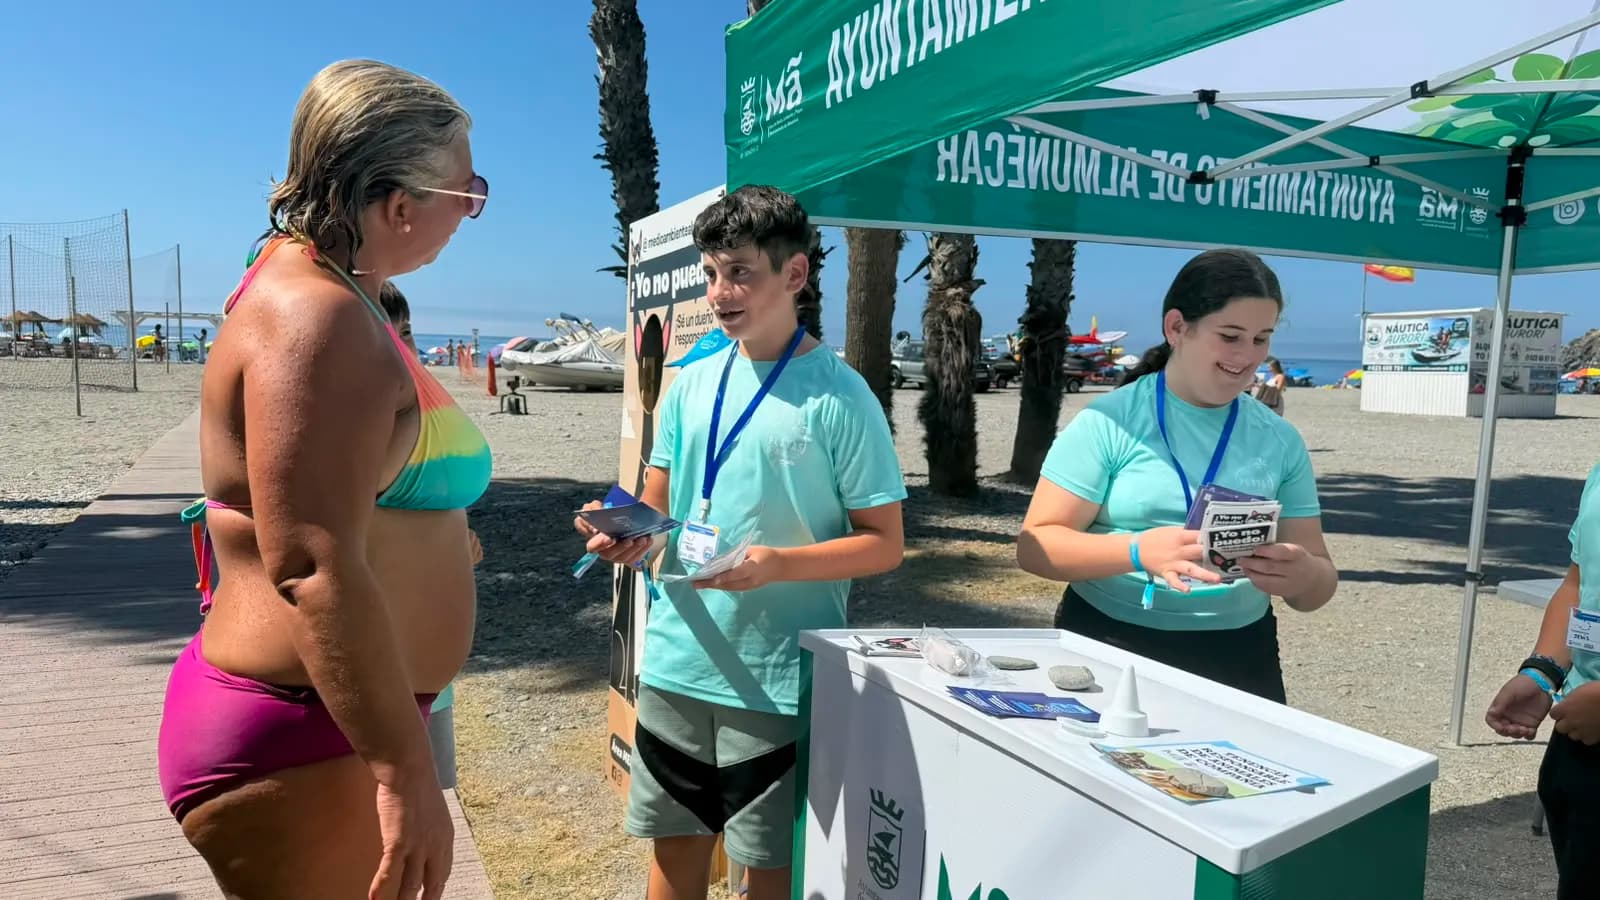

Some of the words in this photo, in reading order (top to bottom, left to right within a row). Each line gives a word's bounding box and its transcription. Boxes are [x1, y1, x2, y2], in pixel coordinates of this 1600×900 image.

[826, 0, 1046, 109] AYUNTAM
[631, 271, 652, 308] ¡Yo
[653, 272, 670, 296] no
[685, 314, 694, 328] un
[695, 308, 714, 328] dueño
[1385, 321, 1429, 334] NÁUTICA
[1385, 333, 1425, 344] AURORI
[1213, 535, 1265, 549] puedo!
[1215, 531, 1238, 541] ¡Yo
[1241, 529, 1261, 537] no
[1201, 747, 1292, 784] RESPONSABLE
